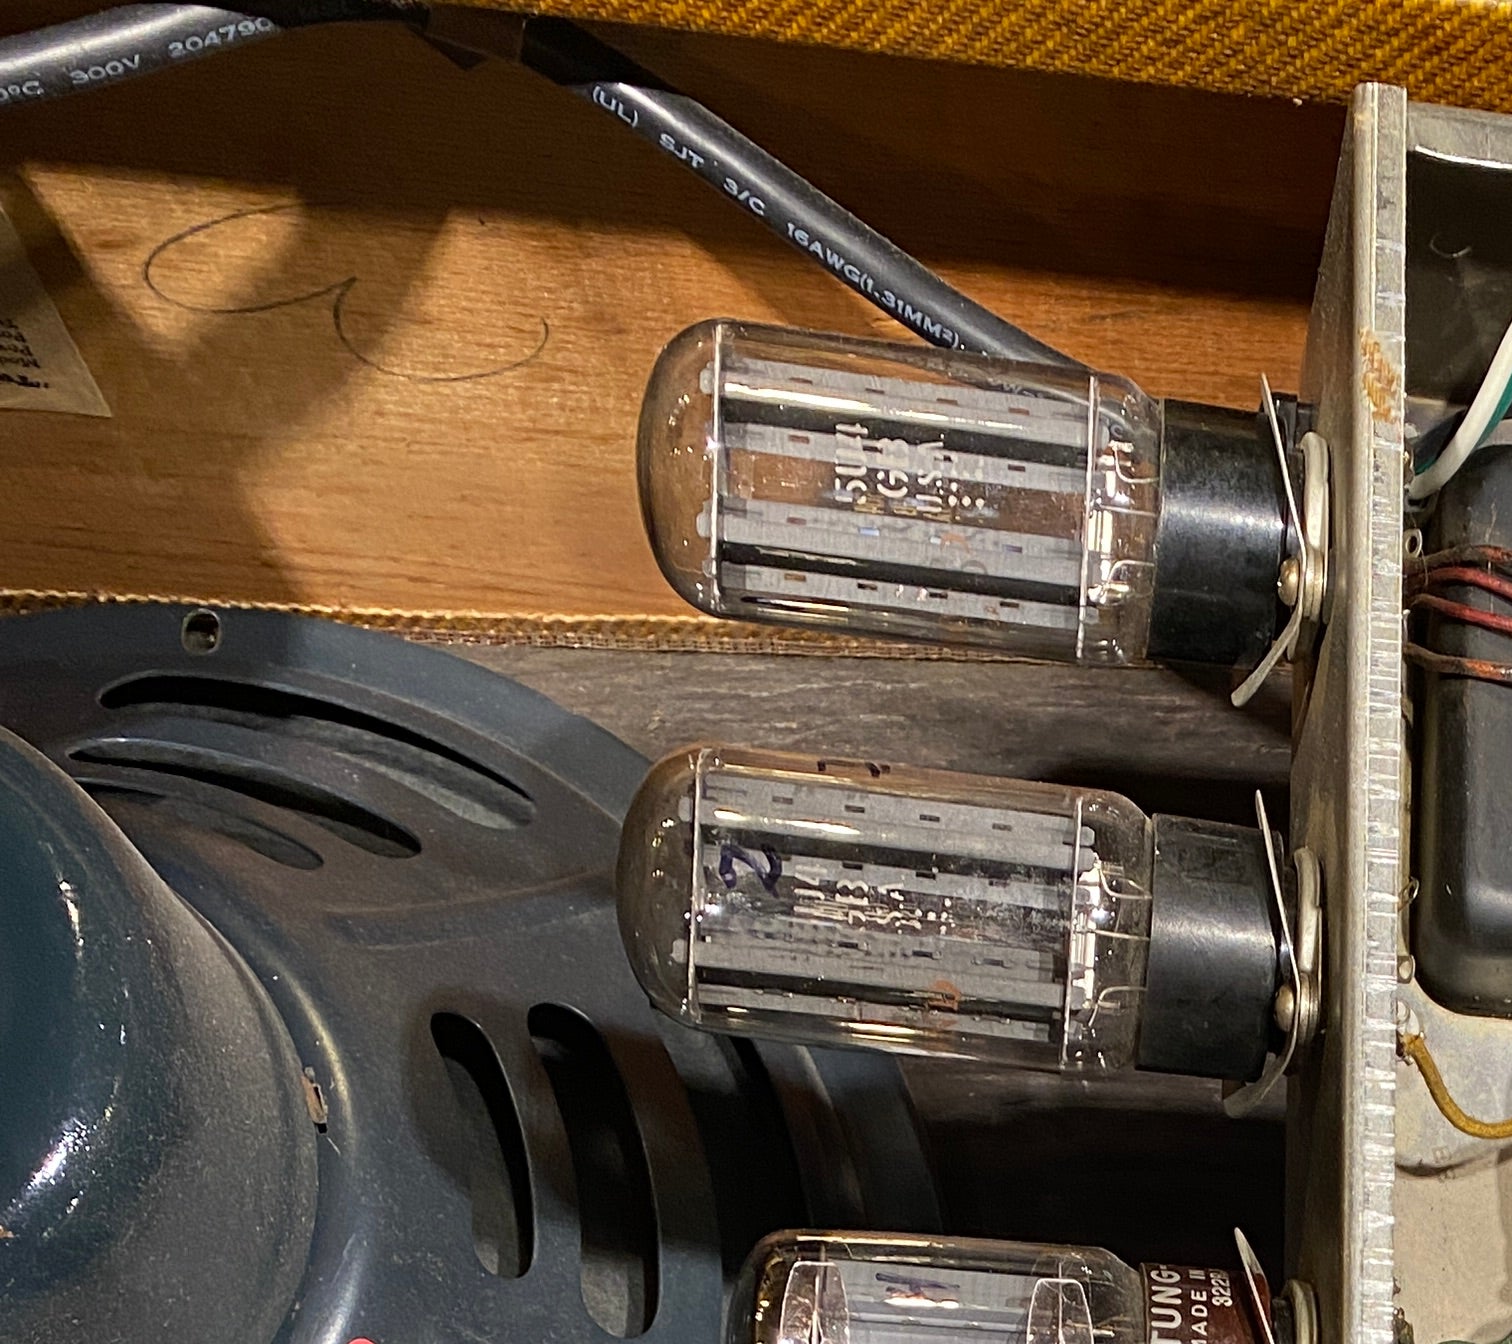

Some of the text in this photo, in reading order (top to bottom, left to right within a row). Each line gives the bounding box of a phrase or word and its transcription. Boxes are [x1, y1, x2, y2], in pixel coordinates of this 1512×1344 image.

[69, 54, 141, 85] 300V
[167, 17, 275, 58] 204790
[659, 132, 706, 169] SJT
[722, 177, 766, 216] 3/C
